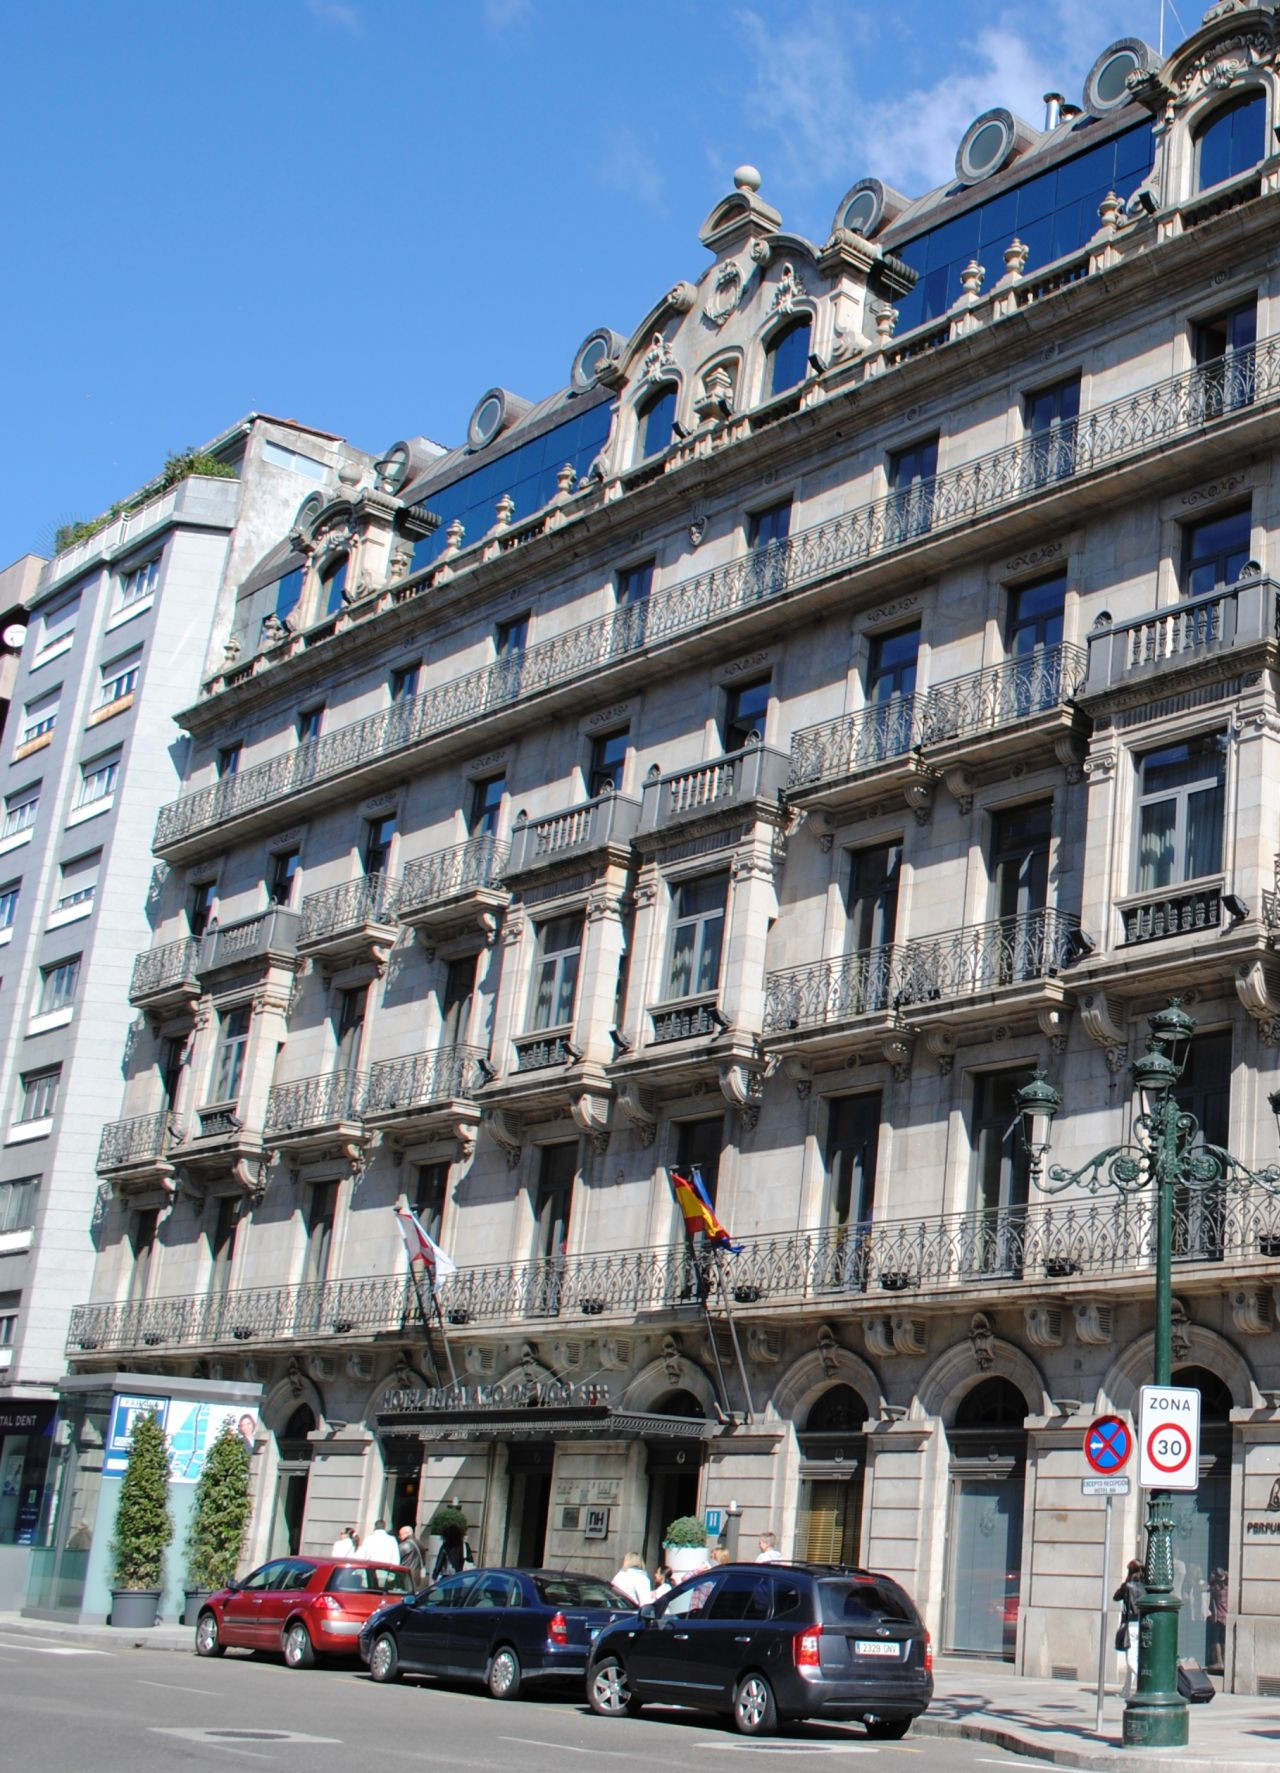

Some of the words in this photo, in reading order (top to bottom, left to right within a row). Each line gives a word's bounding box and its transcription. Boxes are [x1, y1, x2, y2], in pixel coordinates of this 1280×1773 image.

[1150, 1397, 1191, 1411] ZONA
[15, 1414, 37, 1427] DENT
[1158, 1440, 1182, 1456] 30
[863, 1643, 881, 1653] 2329
